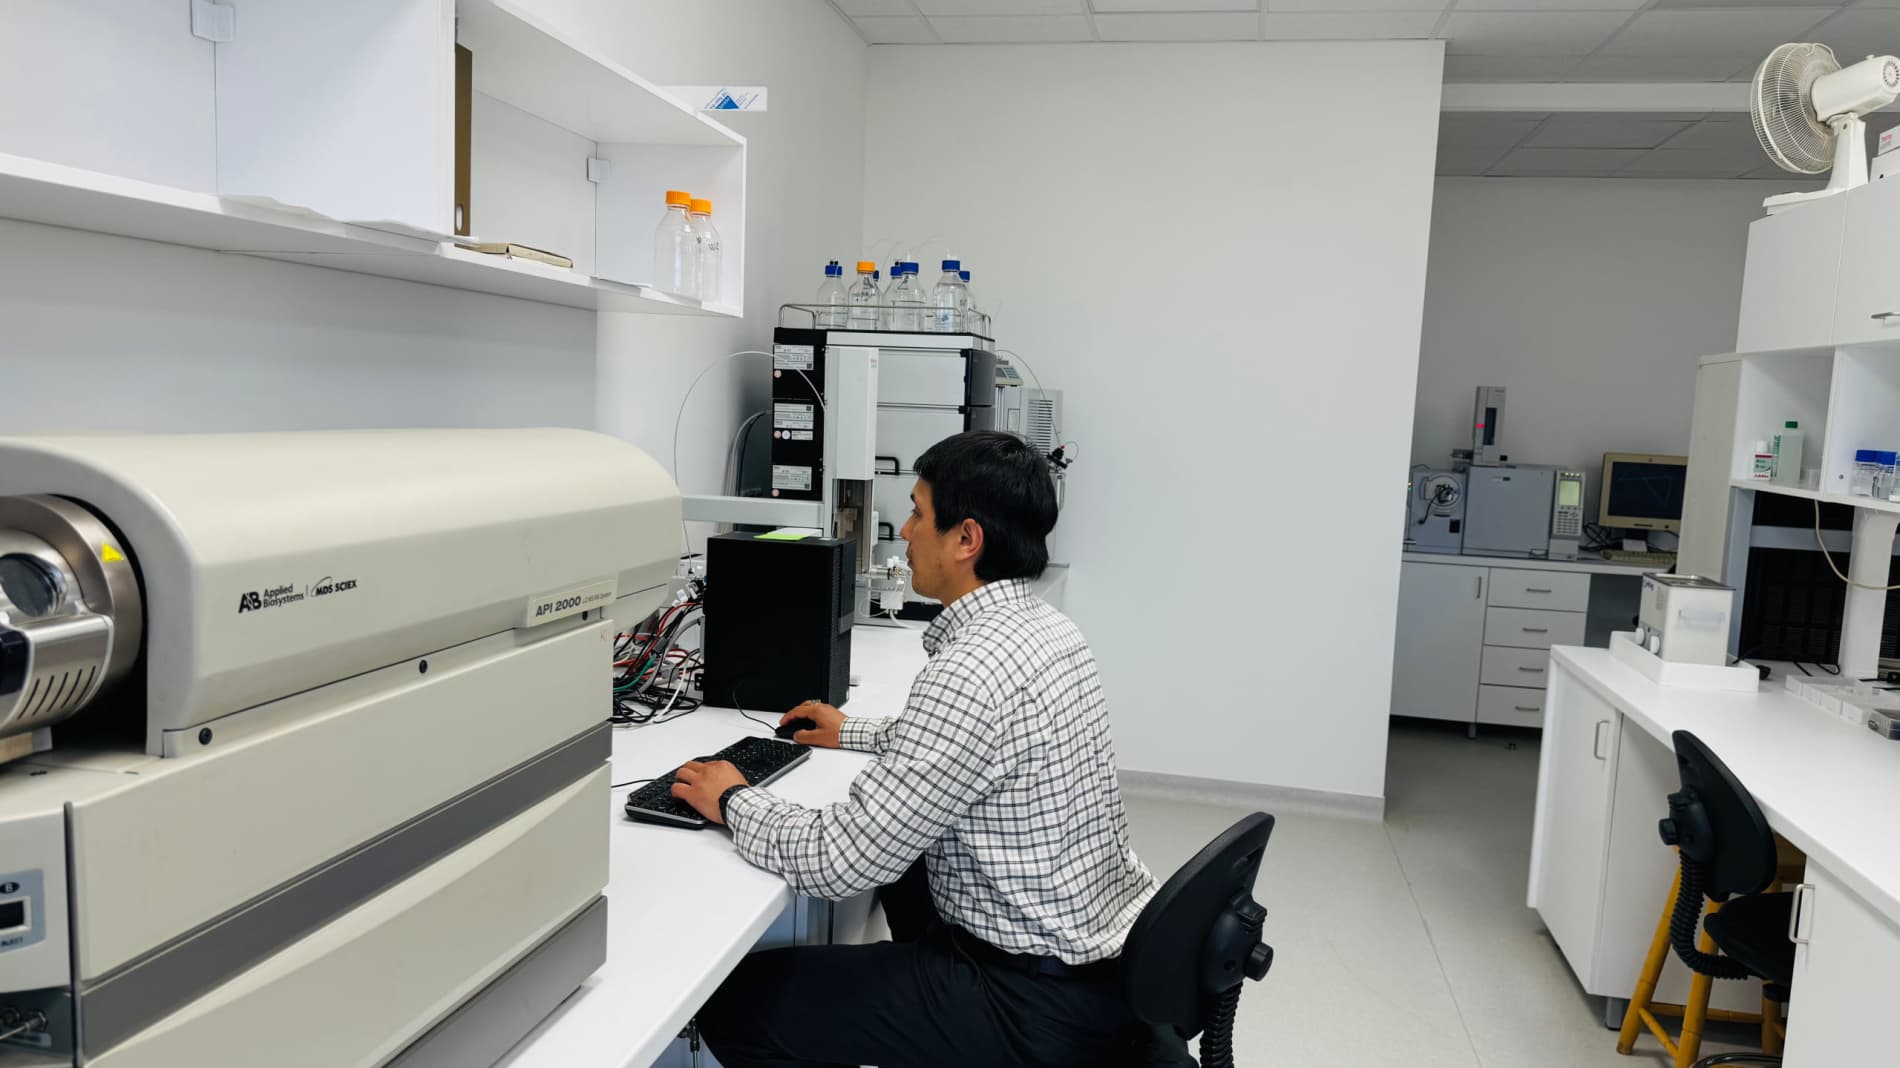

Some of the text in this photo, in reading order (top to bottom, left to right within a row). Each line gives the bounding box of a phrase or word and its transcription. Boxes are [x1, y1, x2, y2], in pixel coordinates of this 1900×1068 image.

[263, 584, 293, 599] Applied
[316, 579, 357, 596] MDS SCIEX
[263, 592, 304, 608] Biosystems
[536, 602, 552, 617] API
[555, 595, 581, 612] 2000
